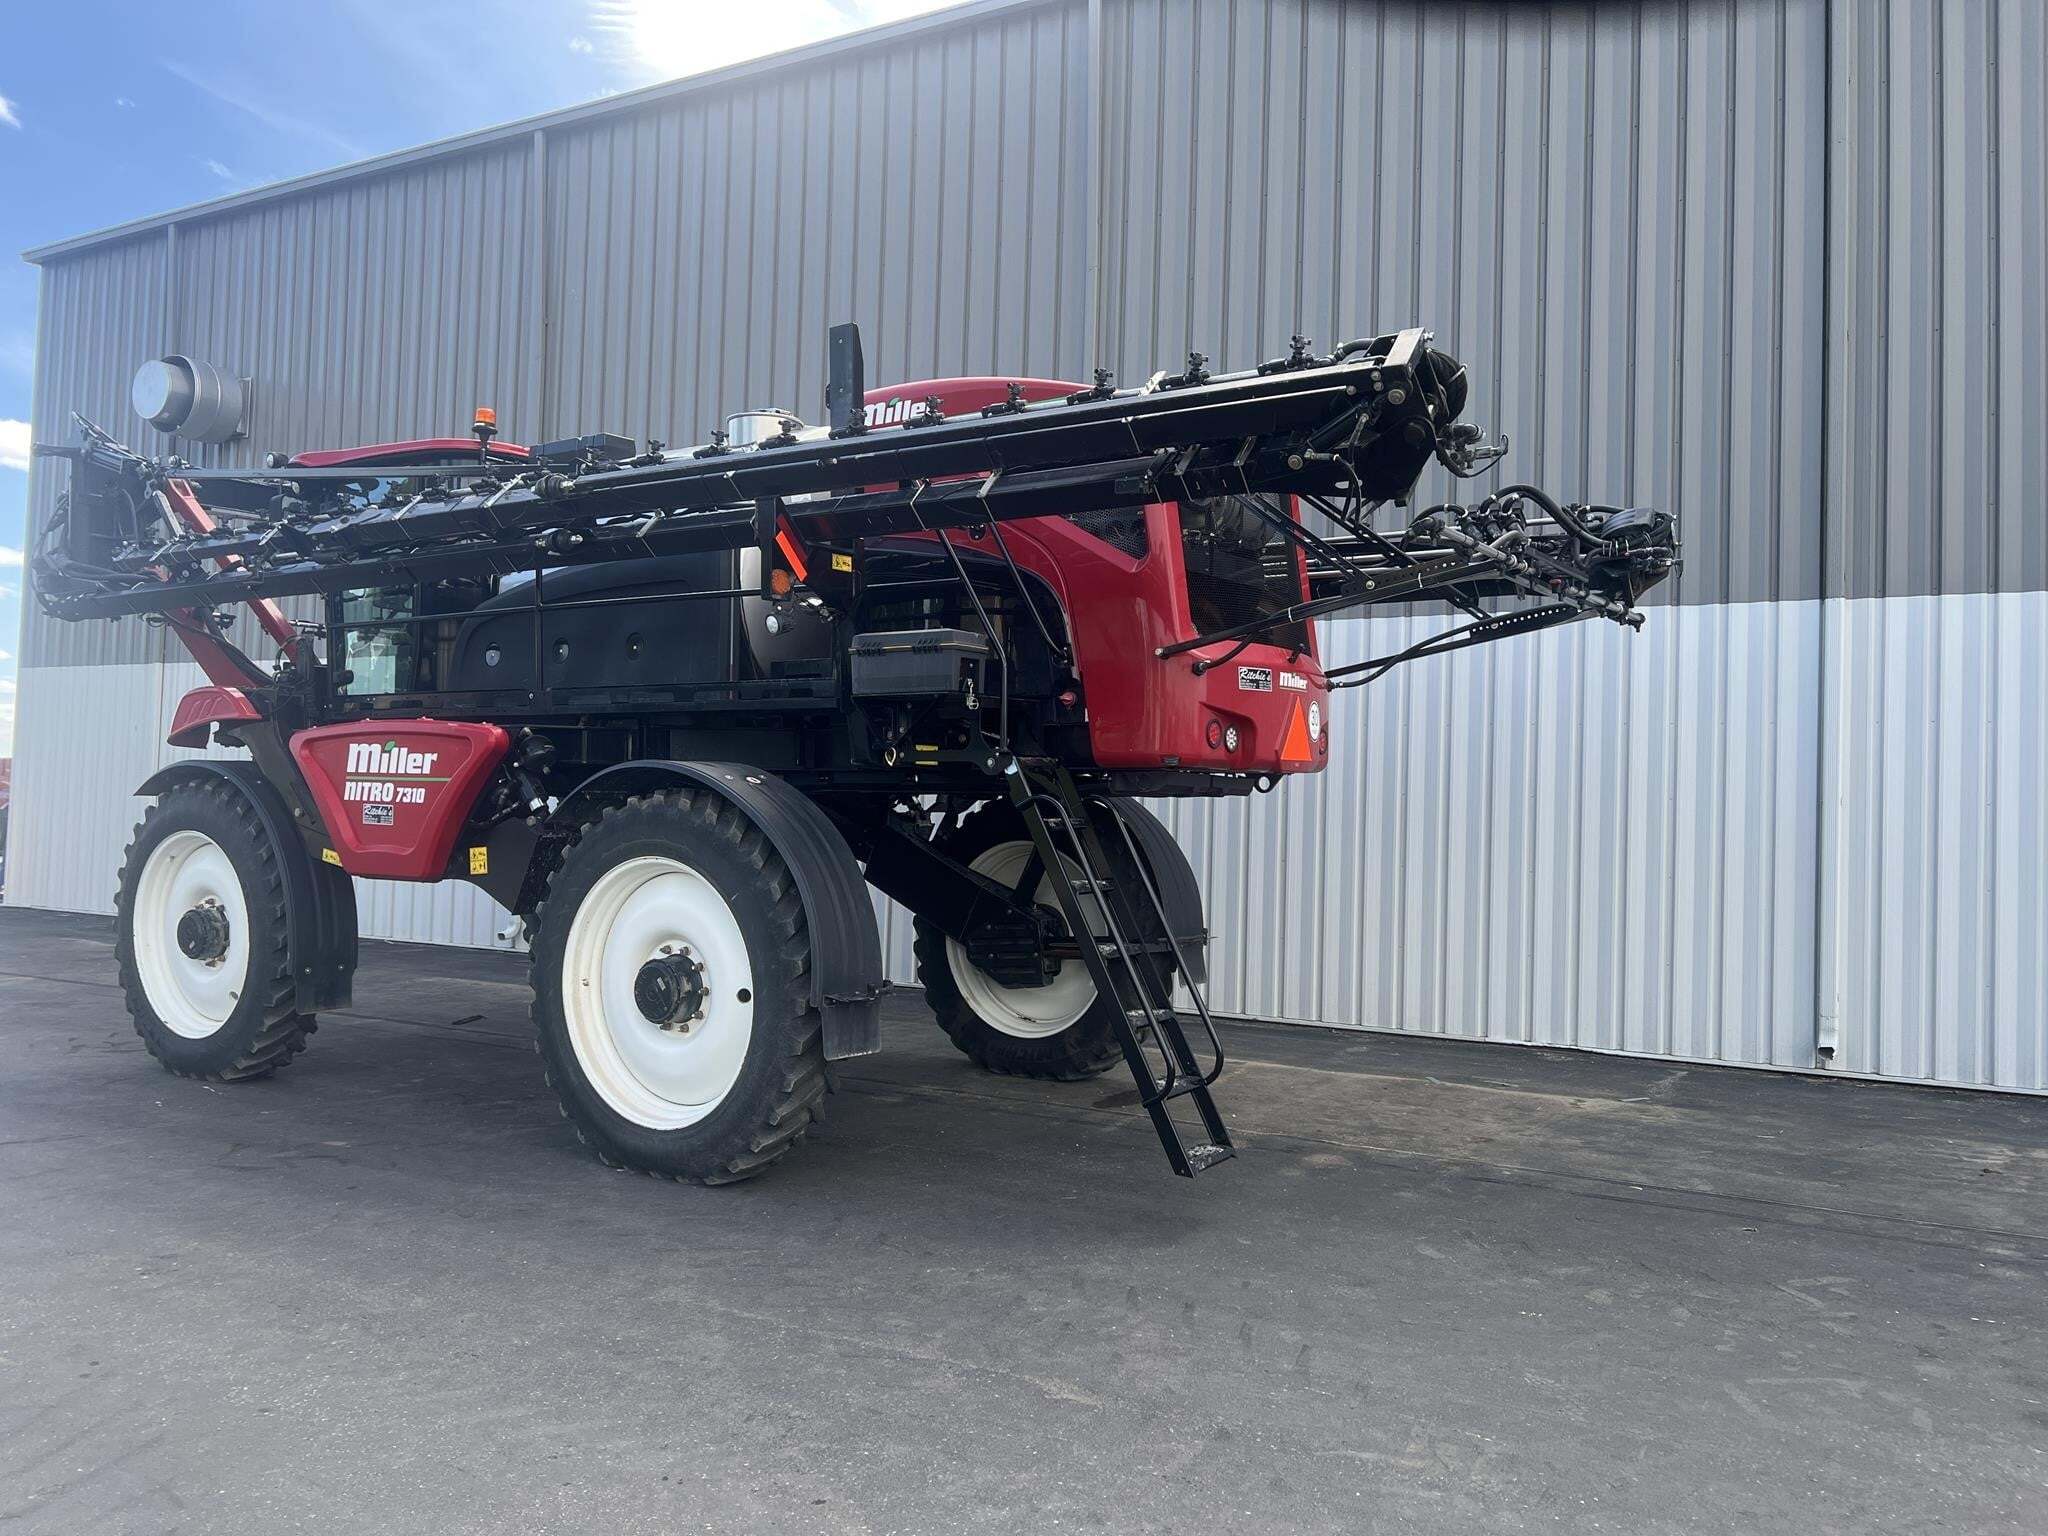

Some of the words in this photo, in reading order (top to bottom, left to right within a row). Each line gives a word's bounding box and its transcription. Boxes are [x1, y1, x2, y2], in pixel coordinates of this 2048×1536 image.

[1280, 671, 1308, 690] Miller
[347, 742, 438, 774] Miller
[344, 781, 394, 802] NITRO
[396, 787, 426, 803] 7310
